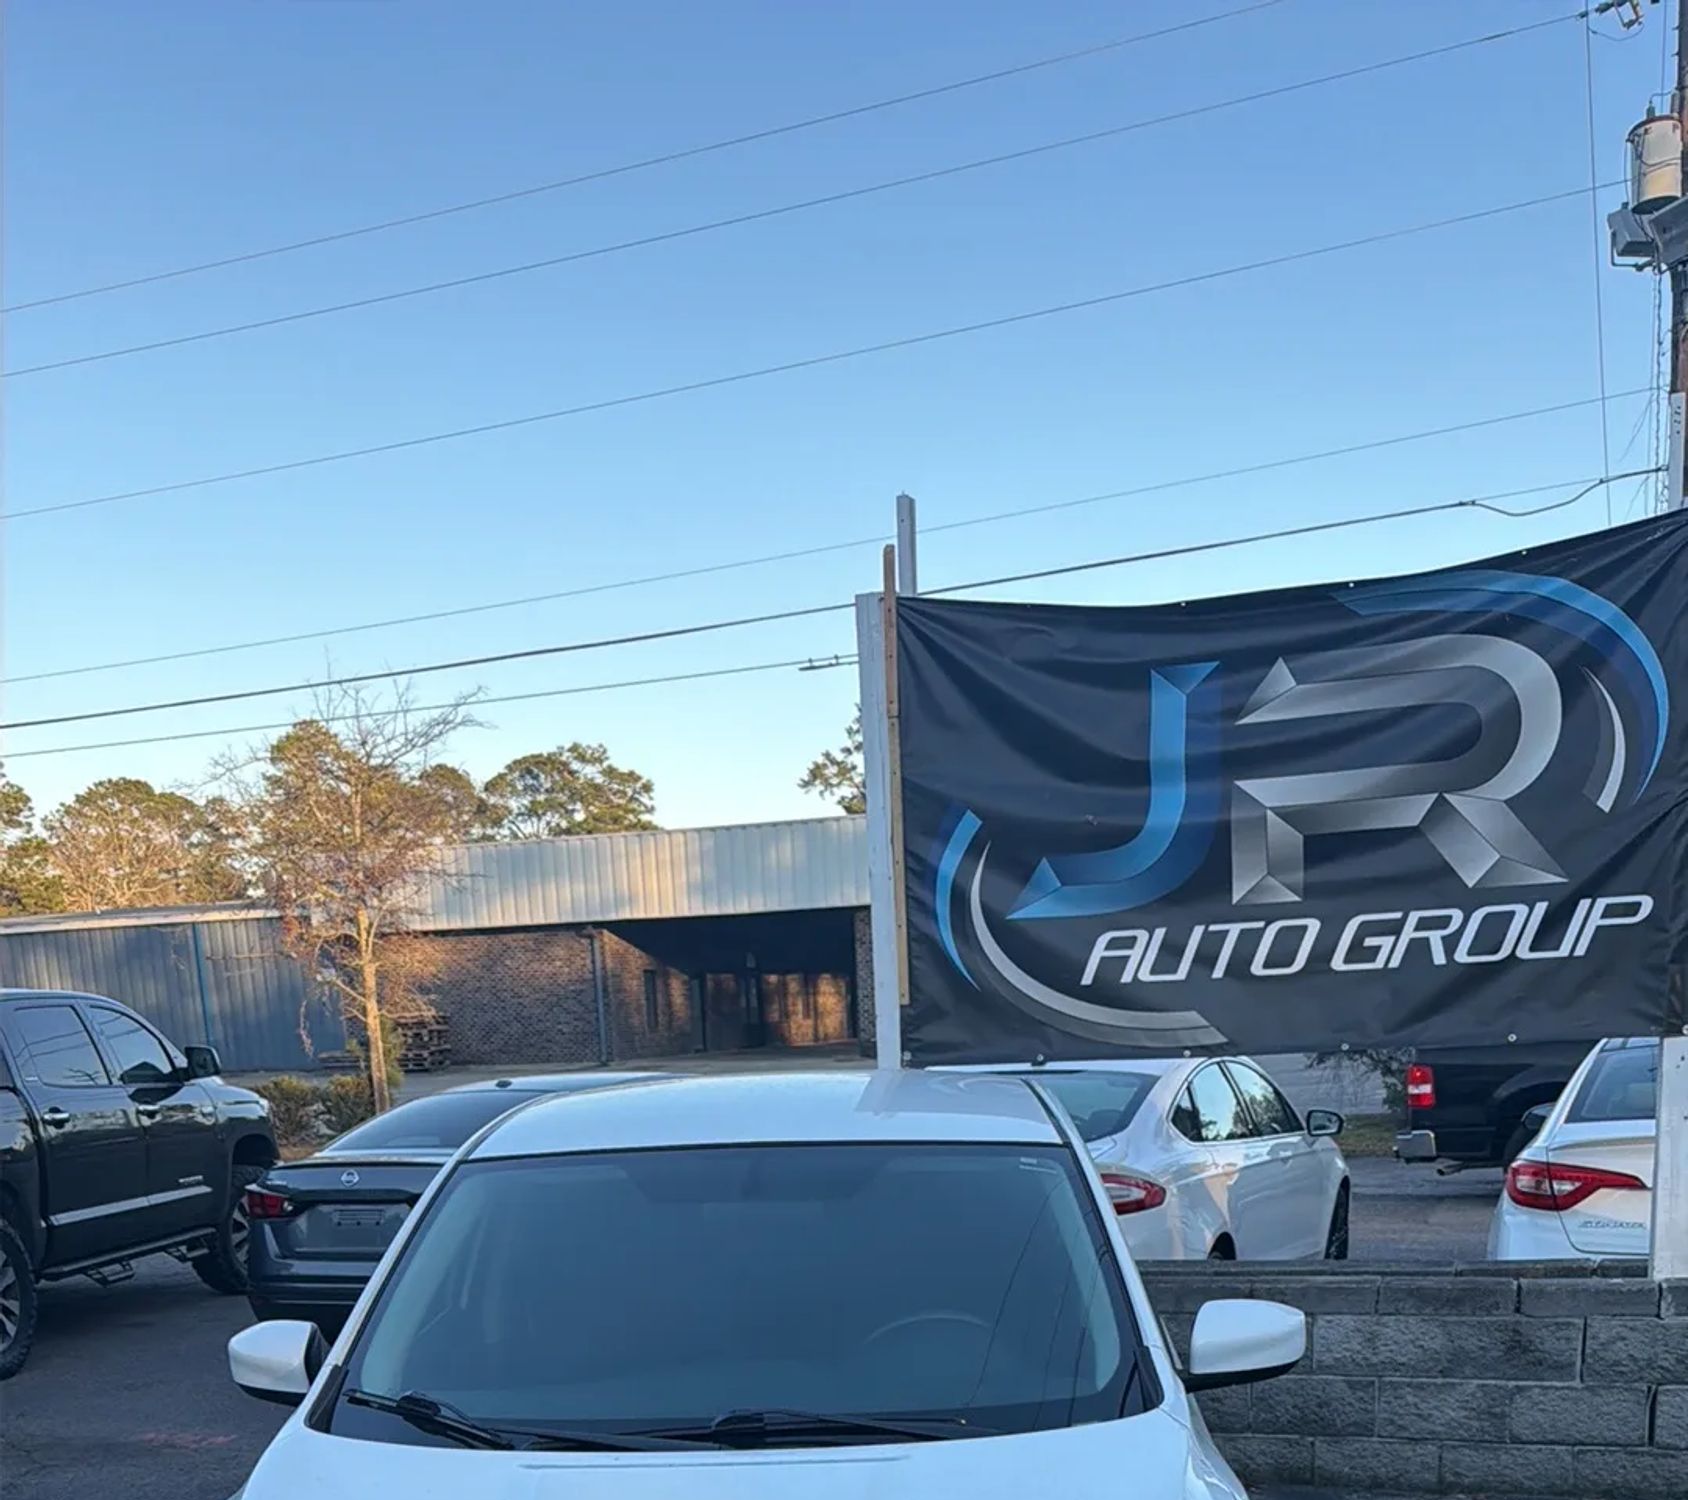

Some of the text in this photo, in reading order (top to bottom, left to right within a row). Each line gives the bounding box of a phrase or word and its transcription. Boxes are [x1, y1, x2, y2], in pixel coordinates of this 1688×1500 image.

[1005, 634, 1569, 920] JR
[1080, 894, 1654, 987] AUTO GROUP
